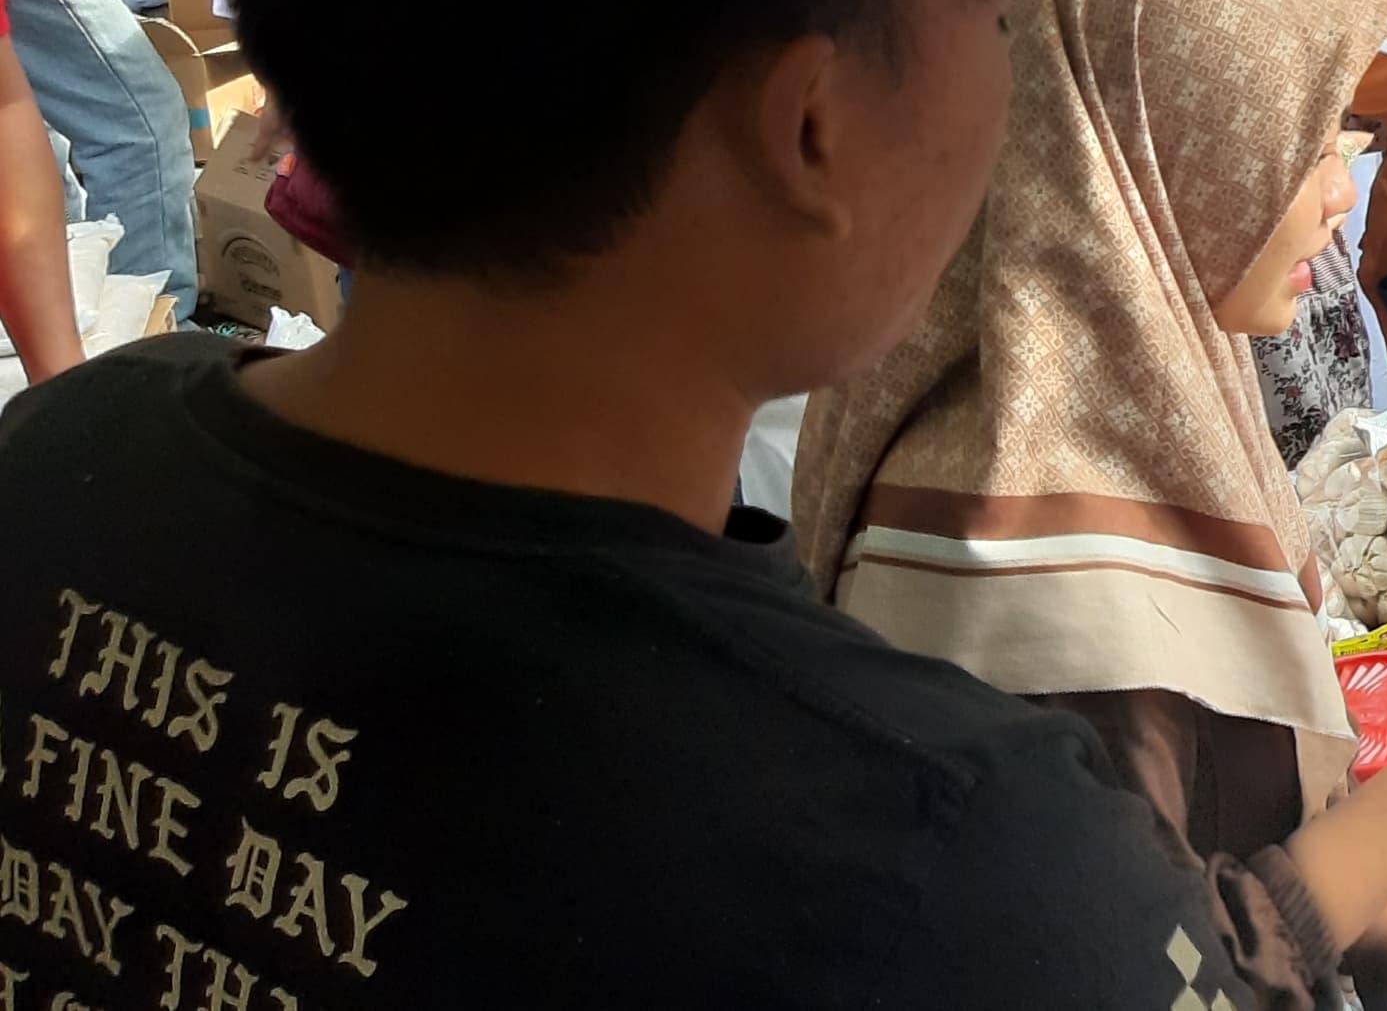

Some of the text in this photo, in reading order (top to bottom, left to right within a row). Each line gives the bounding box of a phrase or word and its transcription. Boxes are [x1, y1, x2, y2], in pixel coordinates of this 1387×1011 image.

[48, 588, 359, 812] THIS IS
[22, 712, 408, 977] FINE DAY
[155, 923, 300, 1011] TH
